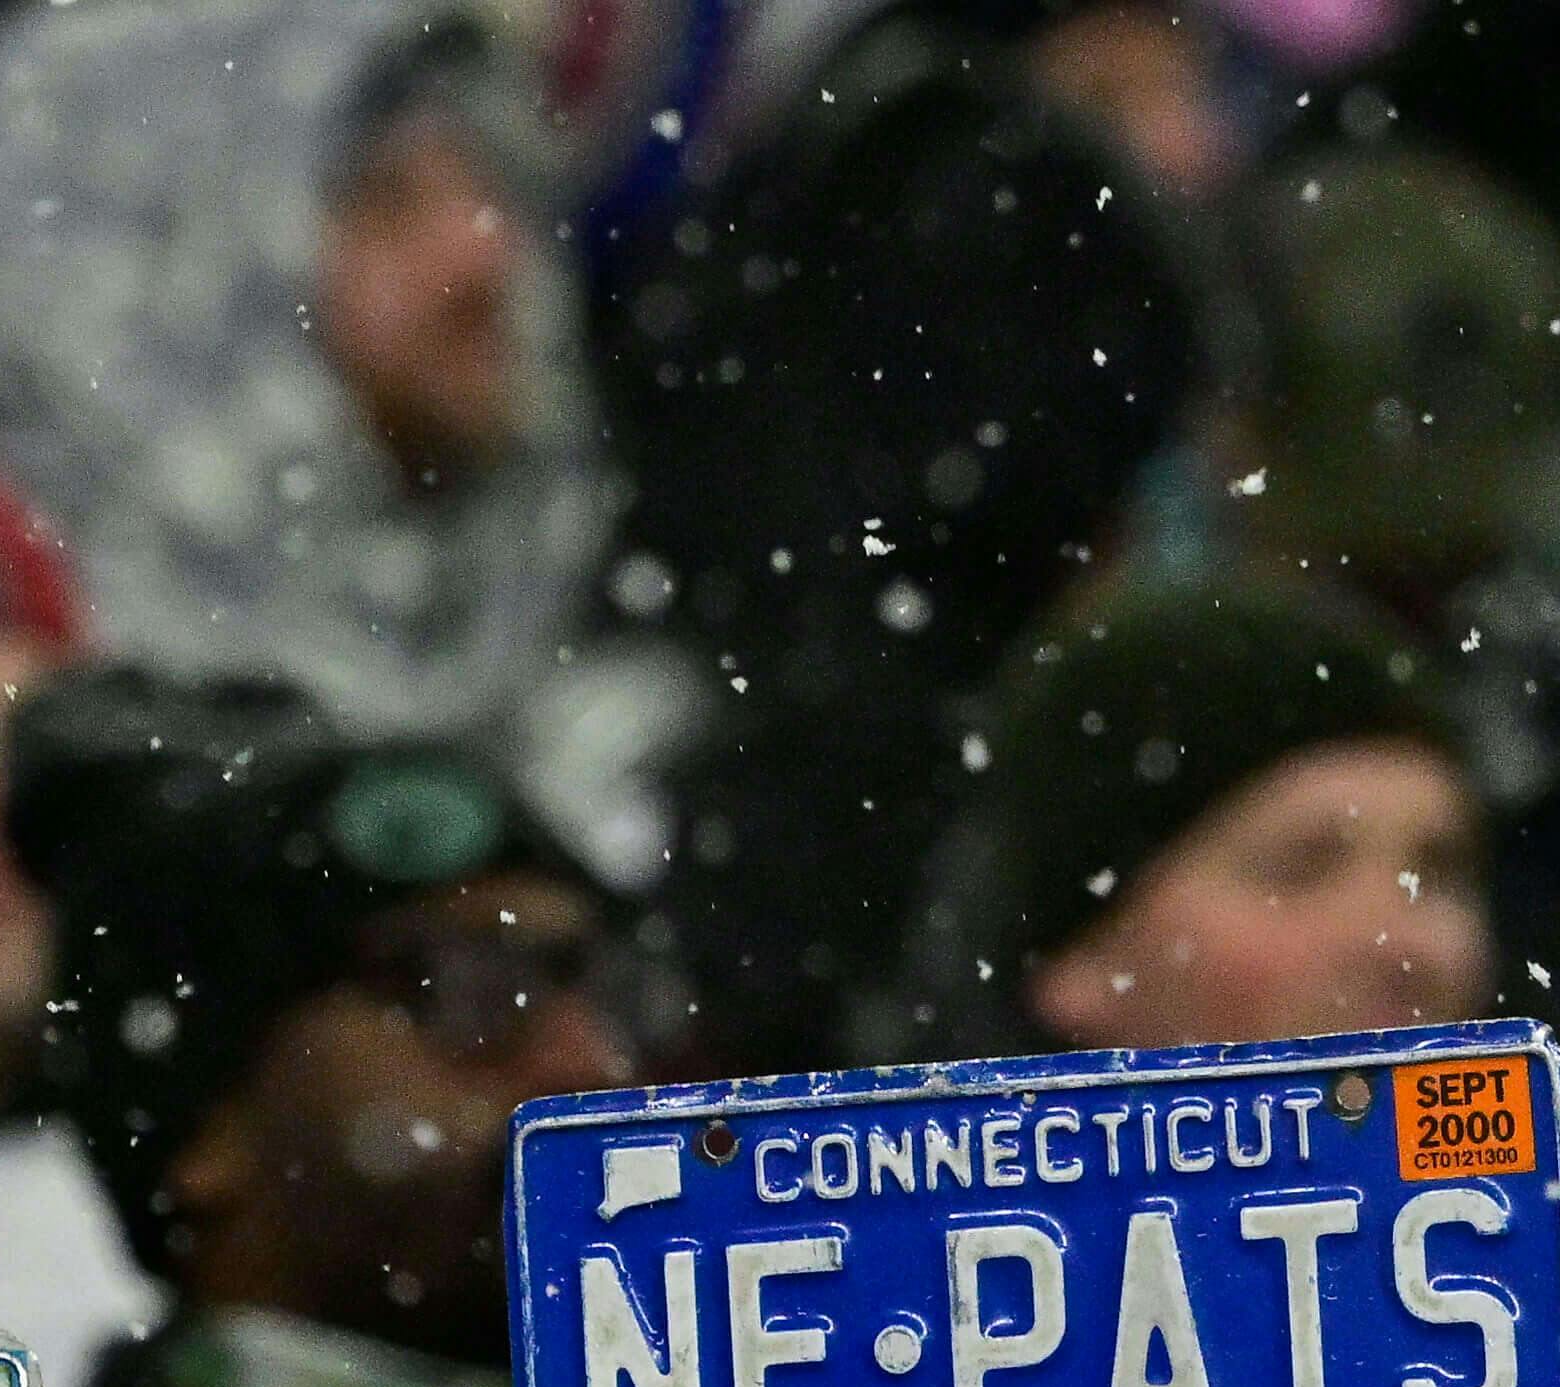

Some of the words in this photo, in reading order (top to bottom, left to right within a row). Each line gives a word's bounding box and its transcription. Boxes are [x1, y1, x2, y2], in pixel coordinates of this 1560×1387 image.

[1415, 1069, 1510, 1109] SEPT
[1416, 1109, 1516, 1150] 2000
[754, 1097, 1322, 1203] CONNECTICUT
[1414, 1147, 1519, 1170] CT0121300
